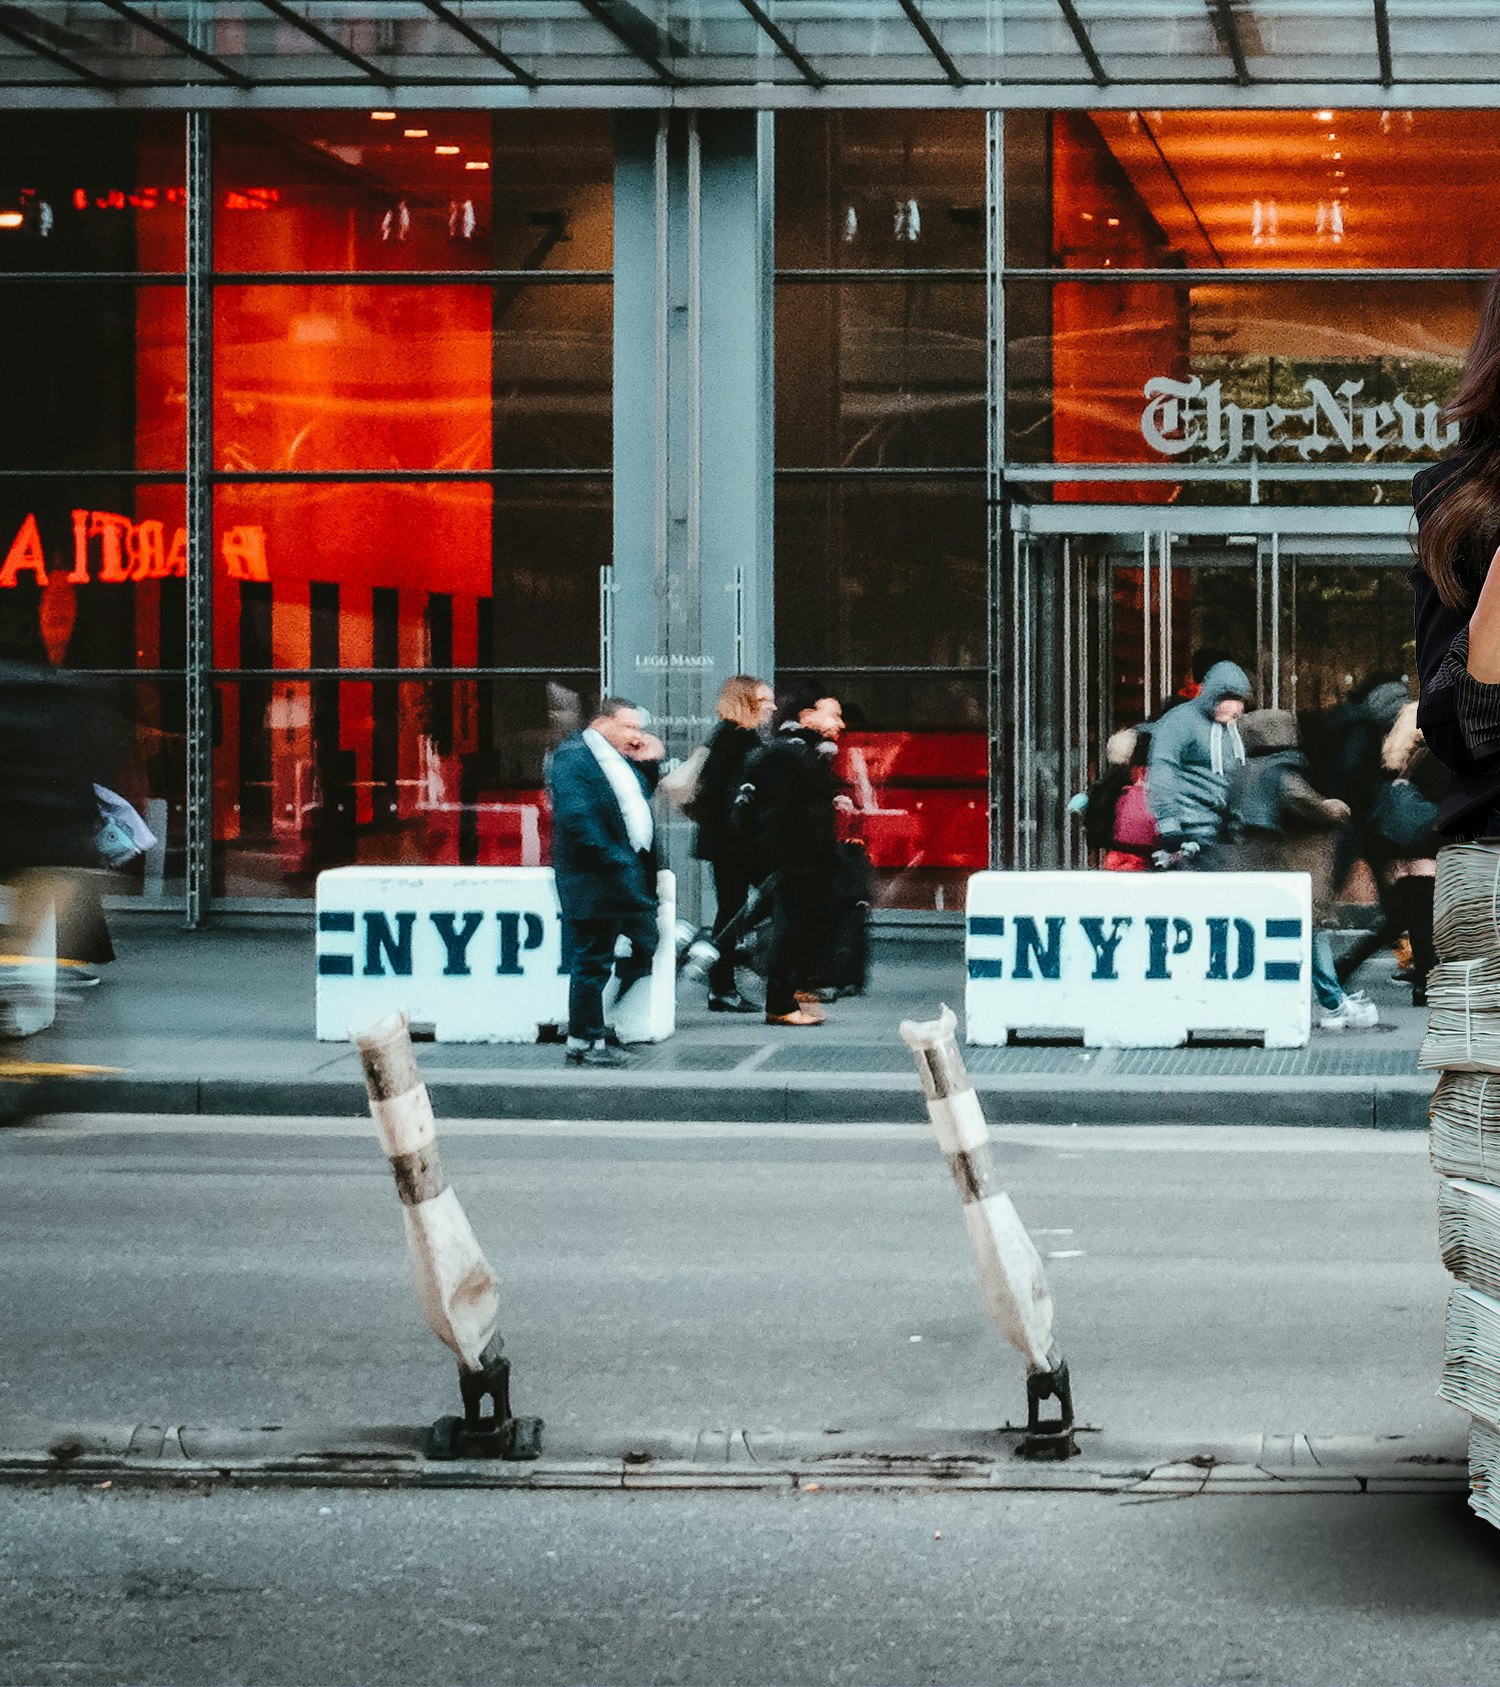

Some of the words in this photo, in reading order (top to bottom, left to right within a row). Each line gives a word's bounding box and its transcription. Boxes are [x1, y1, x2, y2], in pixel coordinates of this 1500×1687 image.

[1141, 374, 1287, 464] The
[1283, 378, 1460, 461] New
[669, 653, 715, 667] MASON
[362, 911, 570, 976] NYP
[1011, 916, 1256, 981] NYPD
